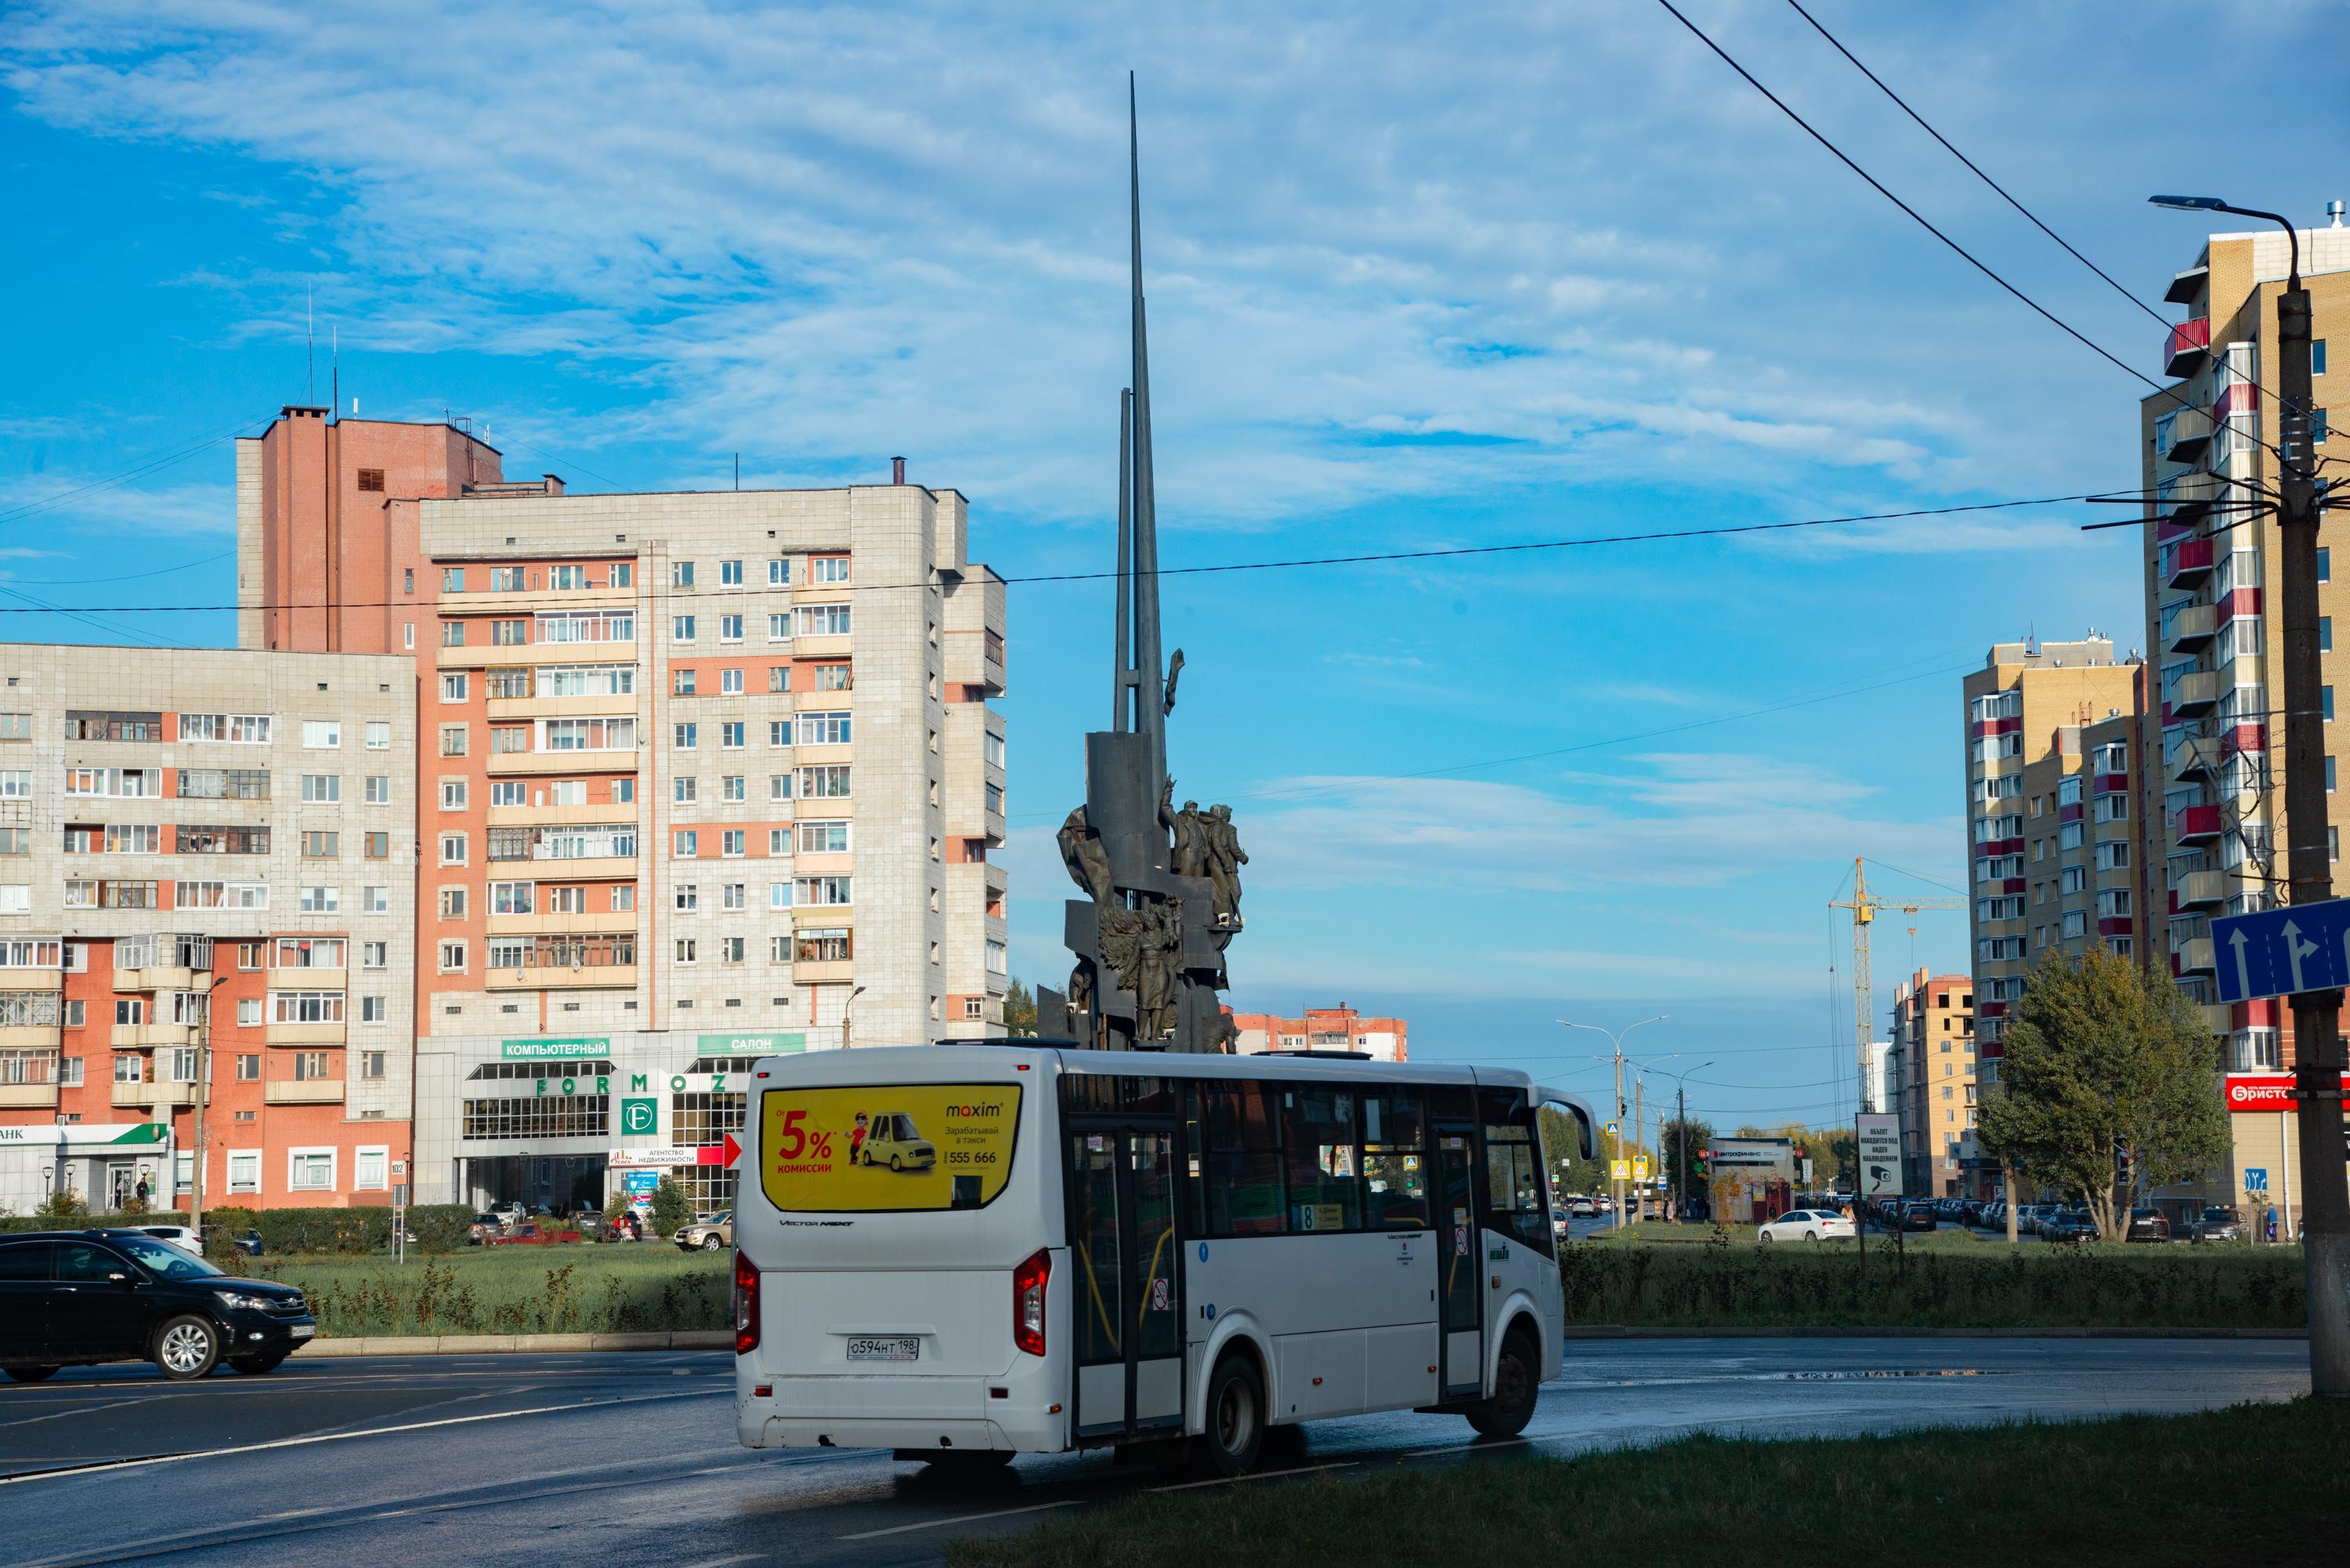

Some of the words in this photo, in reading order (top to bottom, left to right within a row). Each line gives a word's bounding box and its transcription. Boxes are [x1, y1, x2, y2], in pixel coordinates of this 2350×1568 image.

[507, 1041, 606, 1056] КОМПЬЮТЕРНЫЙ
[732, 1039, 772, 1050] САЛОН
[946, 1101, 1000, 1117] maxim
[945, 1126, 998, 1136] Зарабатывай
[949, 1152, 970, 1163] 555
[974, 1152, 996, 1163] 666
[1304, 1206, 1313, 1229] 8
[898, 1339, 914, 1350] 198
